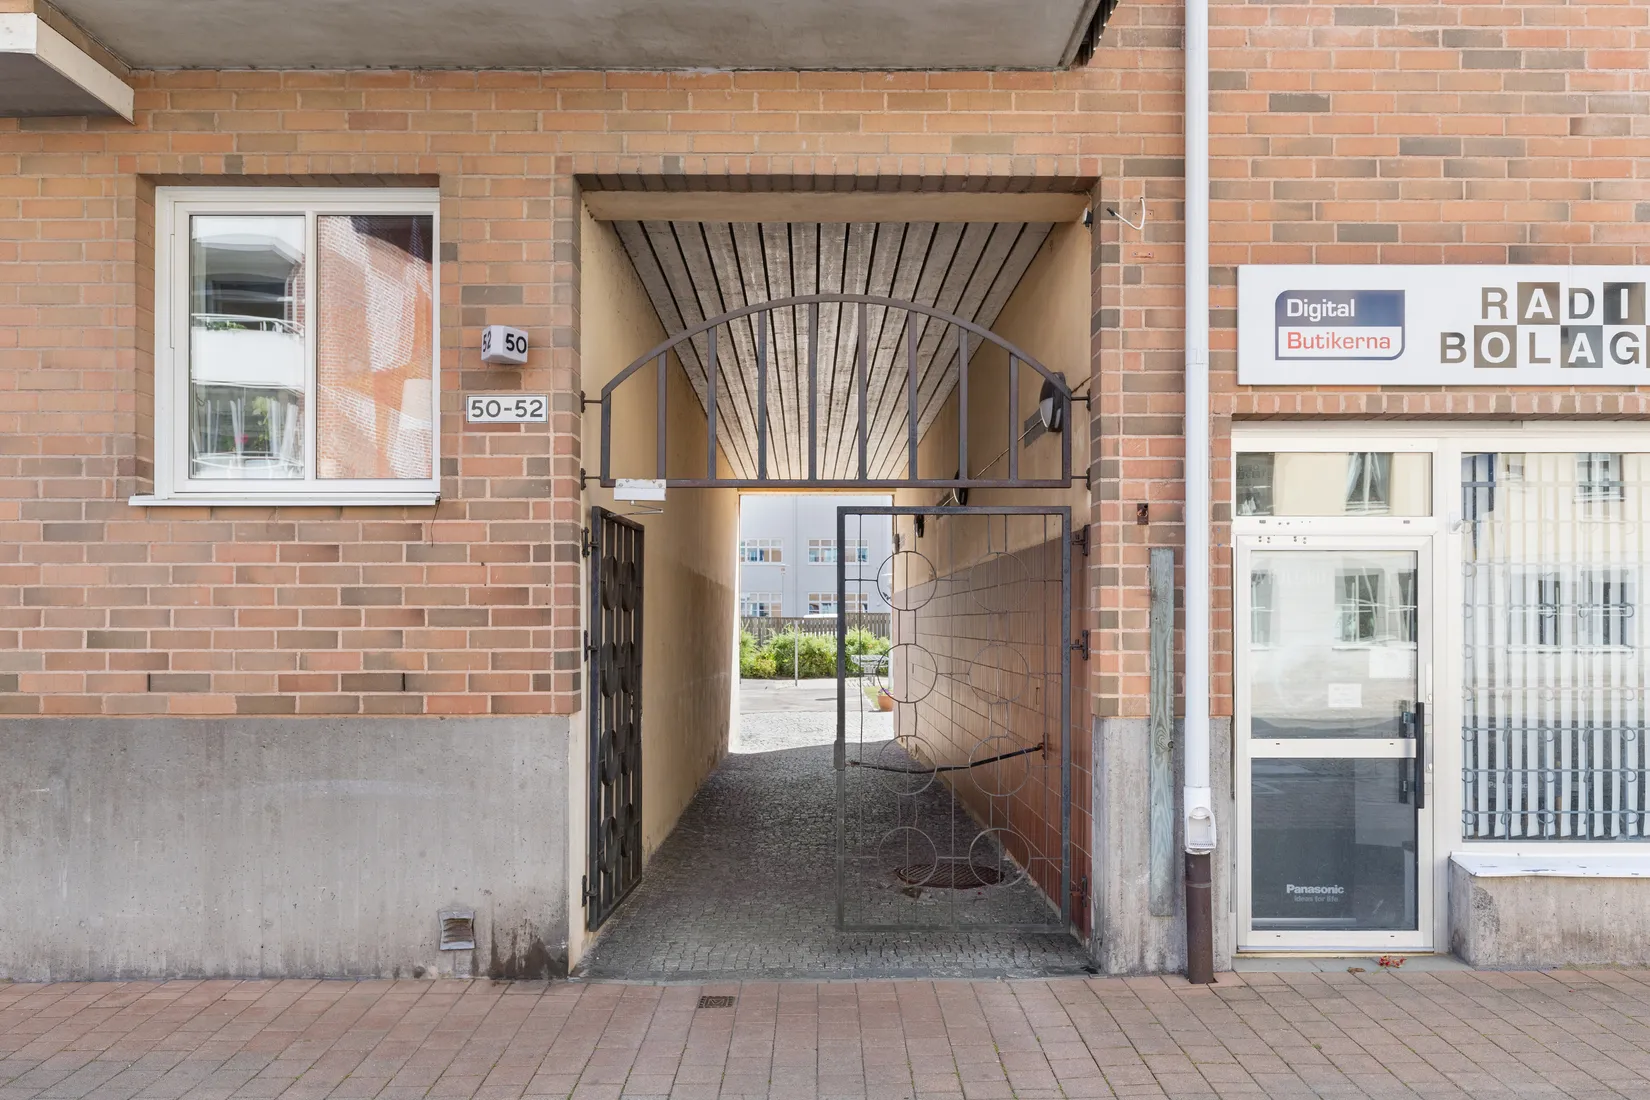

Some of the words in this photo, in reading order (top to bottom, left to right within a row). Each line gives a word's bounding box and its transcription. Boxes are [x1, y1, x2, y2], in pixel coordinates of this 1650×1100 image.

[1287, 299, 1355, 322] Digital
[1482, 287, 1628, 319] RADI
[482, 330, 492, 352] 52
[505, 333, 527, 354] 50
[1287, 331, 1391, 350] Butikerna
[1440, 331, 1640, 365] BOLAG
[471, 399, 543, 418] 50-52
[1286, 884, 1344, 894] Panasonic
